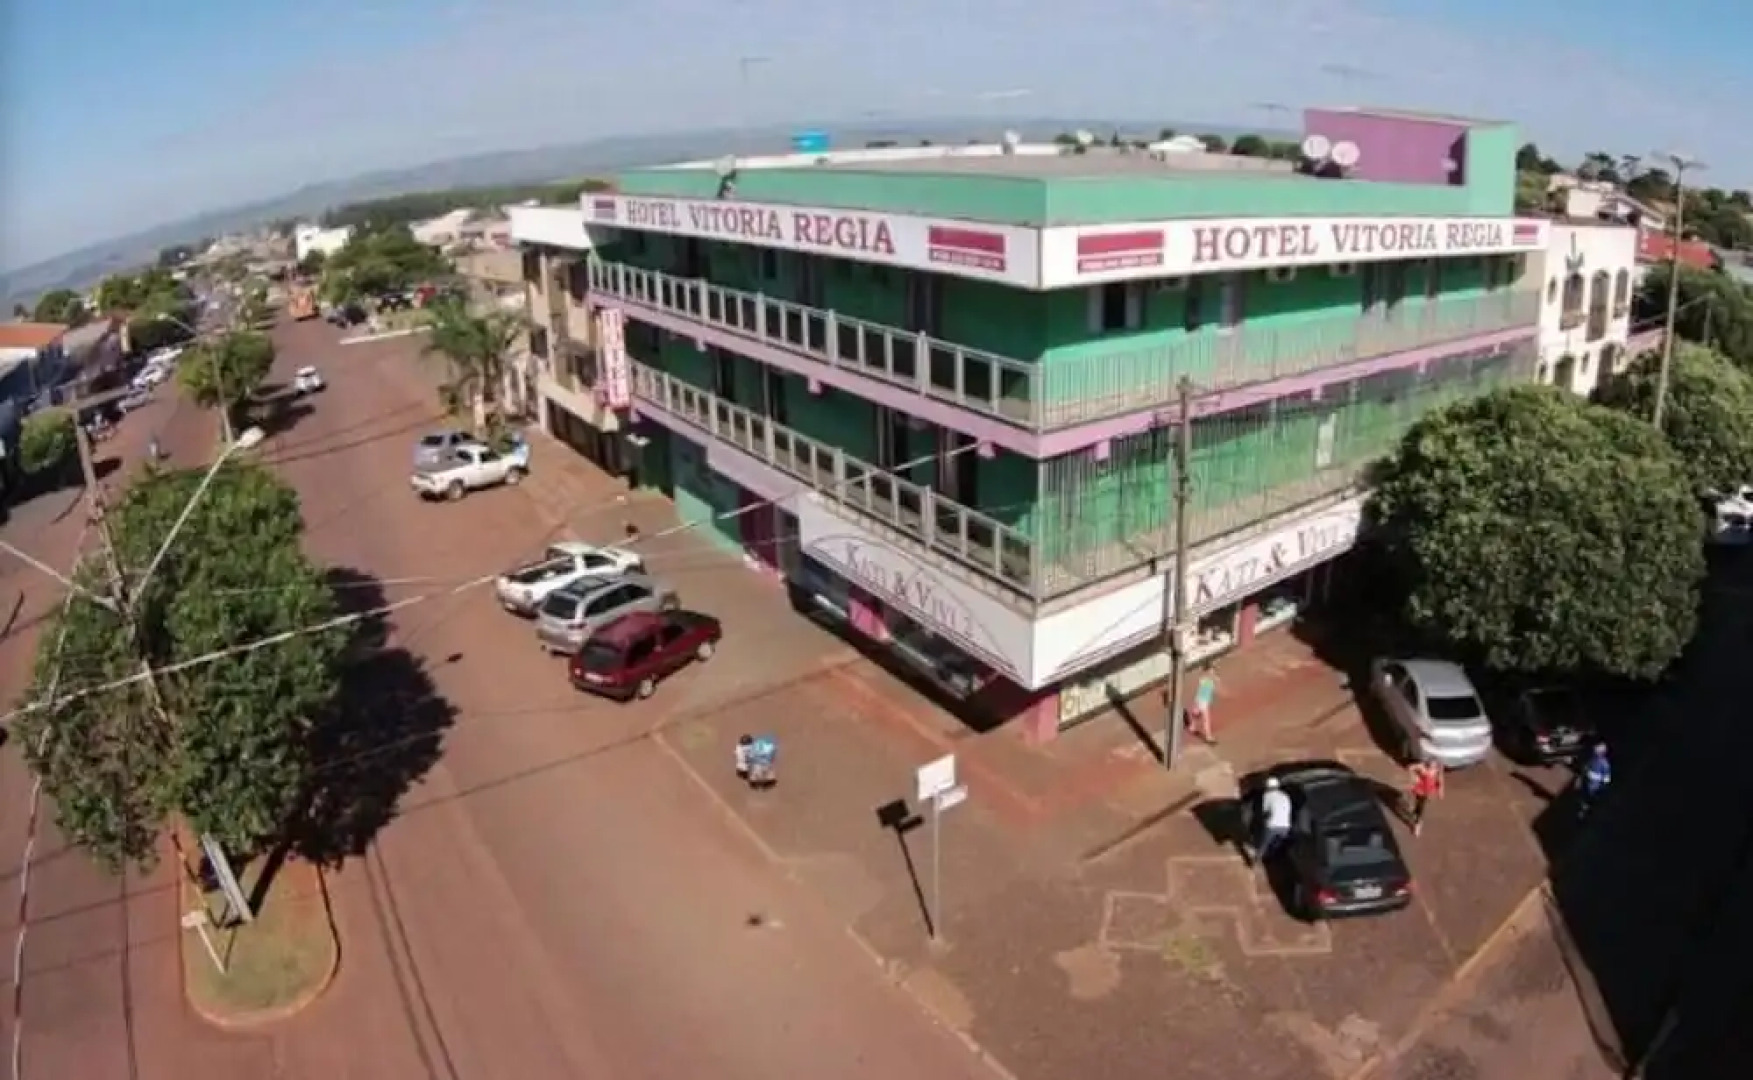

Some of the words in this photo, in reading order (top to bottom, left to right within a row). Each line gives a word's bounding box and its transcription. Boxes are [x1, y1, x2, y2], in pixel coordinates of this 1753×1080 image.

[626, 200, 681, 227] HOTEL
[688, 204, 783, 240] VITORIA
[791, 212, 896, 254] REGIA
[1191, 224, 1319, 262] HOTEL
[1331, 223, 1438, 252] VITORIA
[1445, 222, 1503, 250] REGIA
